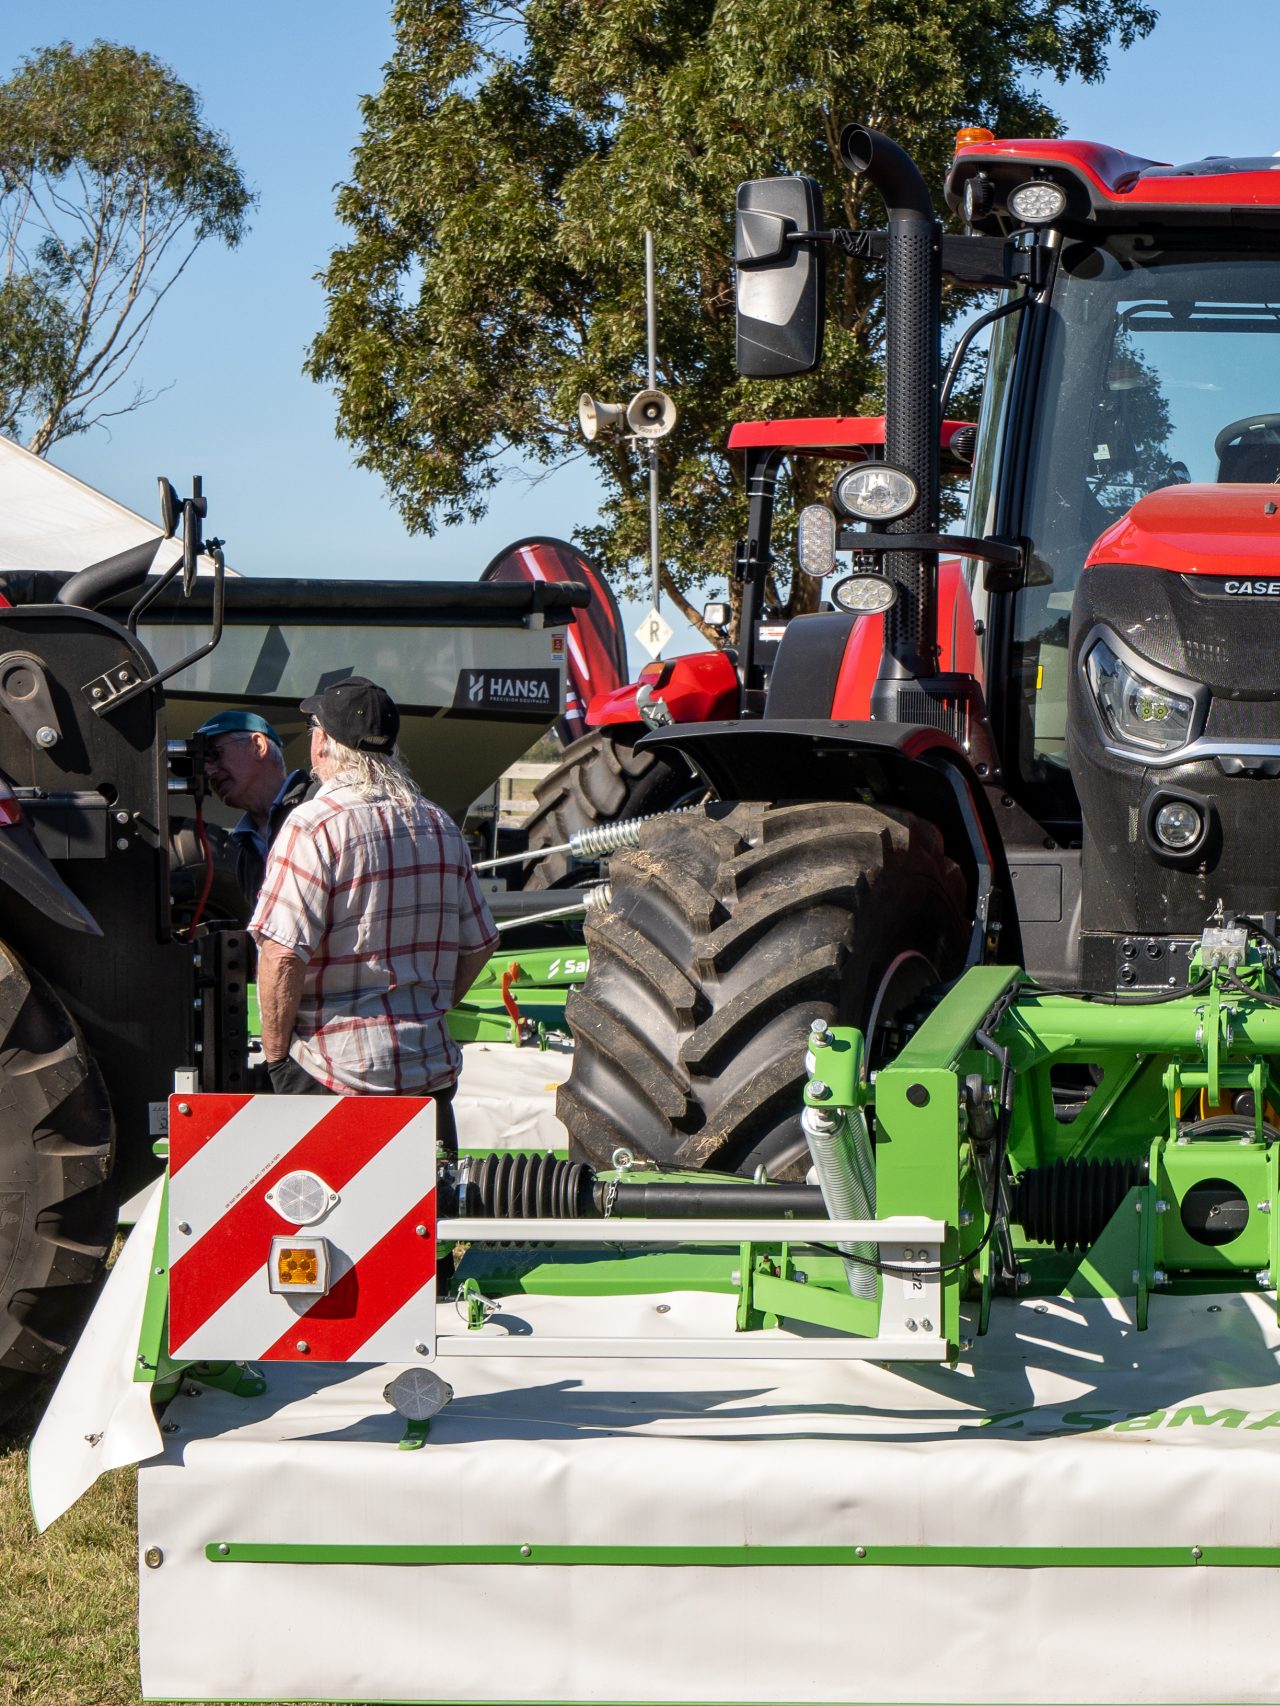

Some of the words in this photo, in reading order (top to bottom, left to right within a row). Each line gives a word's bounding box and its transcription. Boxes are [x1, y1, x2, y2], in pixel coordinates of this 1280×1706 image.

[649, 620, 660, 642] R
[490, 678, 550, 699] HANSA
[564, 959, 590, 974] Sa
